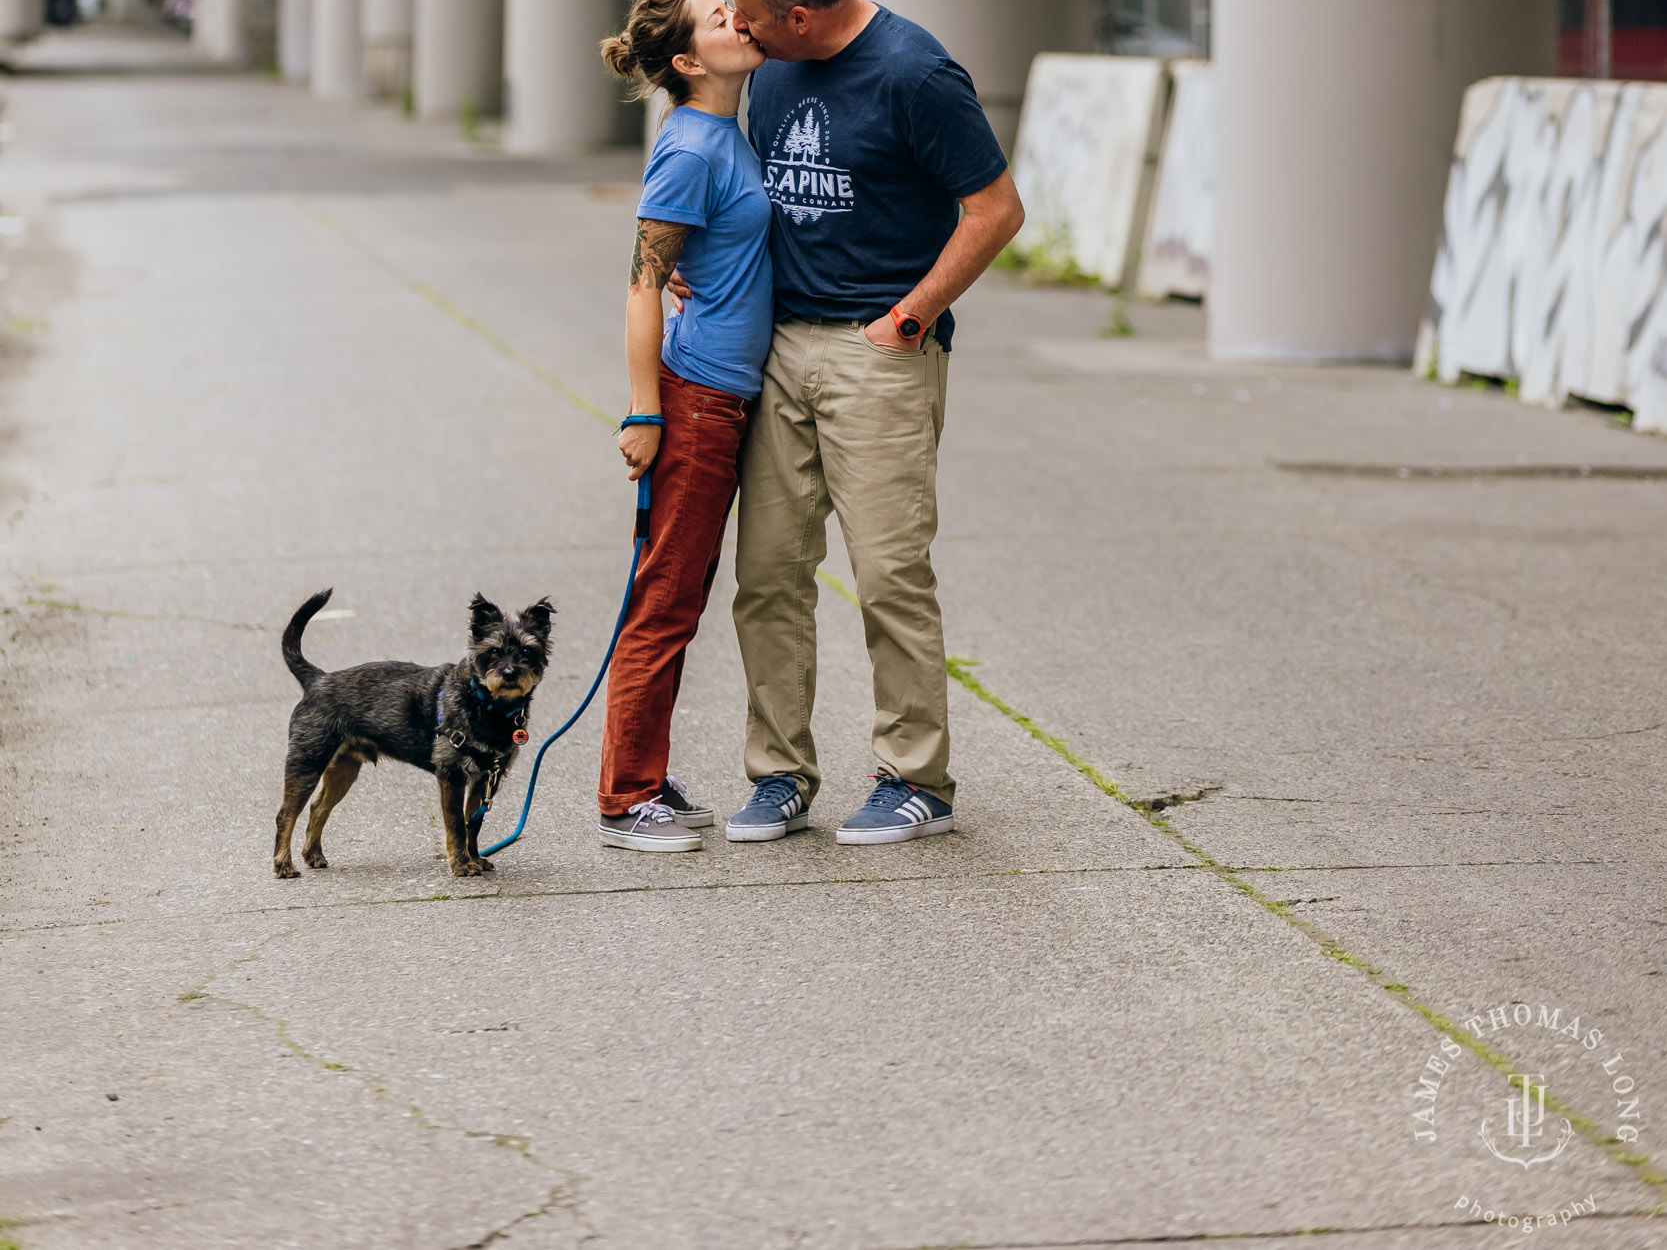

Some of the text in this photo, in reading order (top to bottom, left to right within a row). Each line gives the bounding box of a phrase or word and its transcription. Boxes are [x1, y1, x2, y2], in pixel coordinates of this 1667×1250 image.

[773, 109, 795, 147] QUALITY
[819, 101, 830, 126] SINCE
[802, 197, 855, 207] COMPANY
